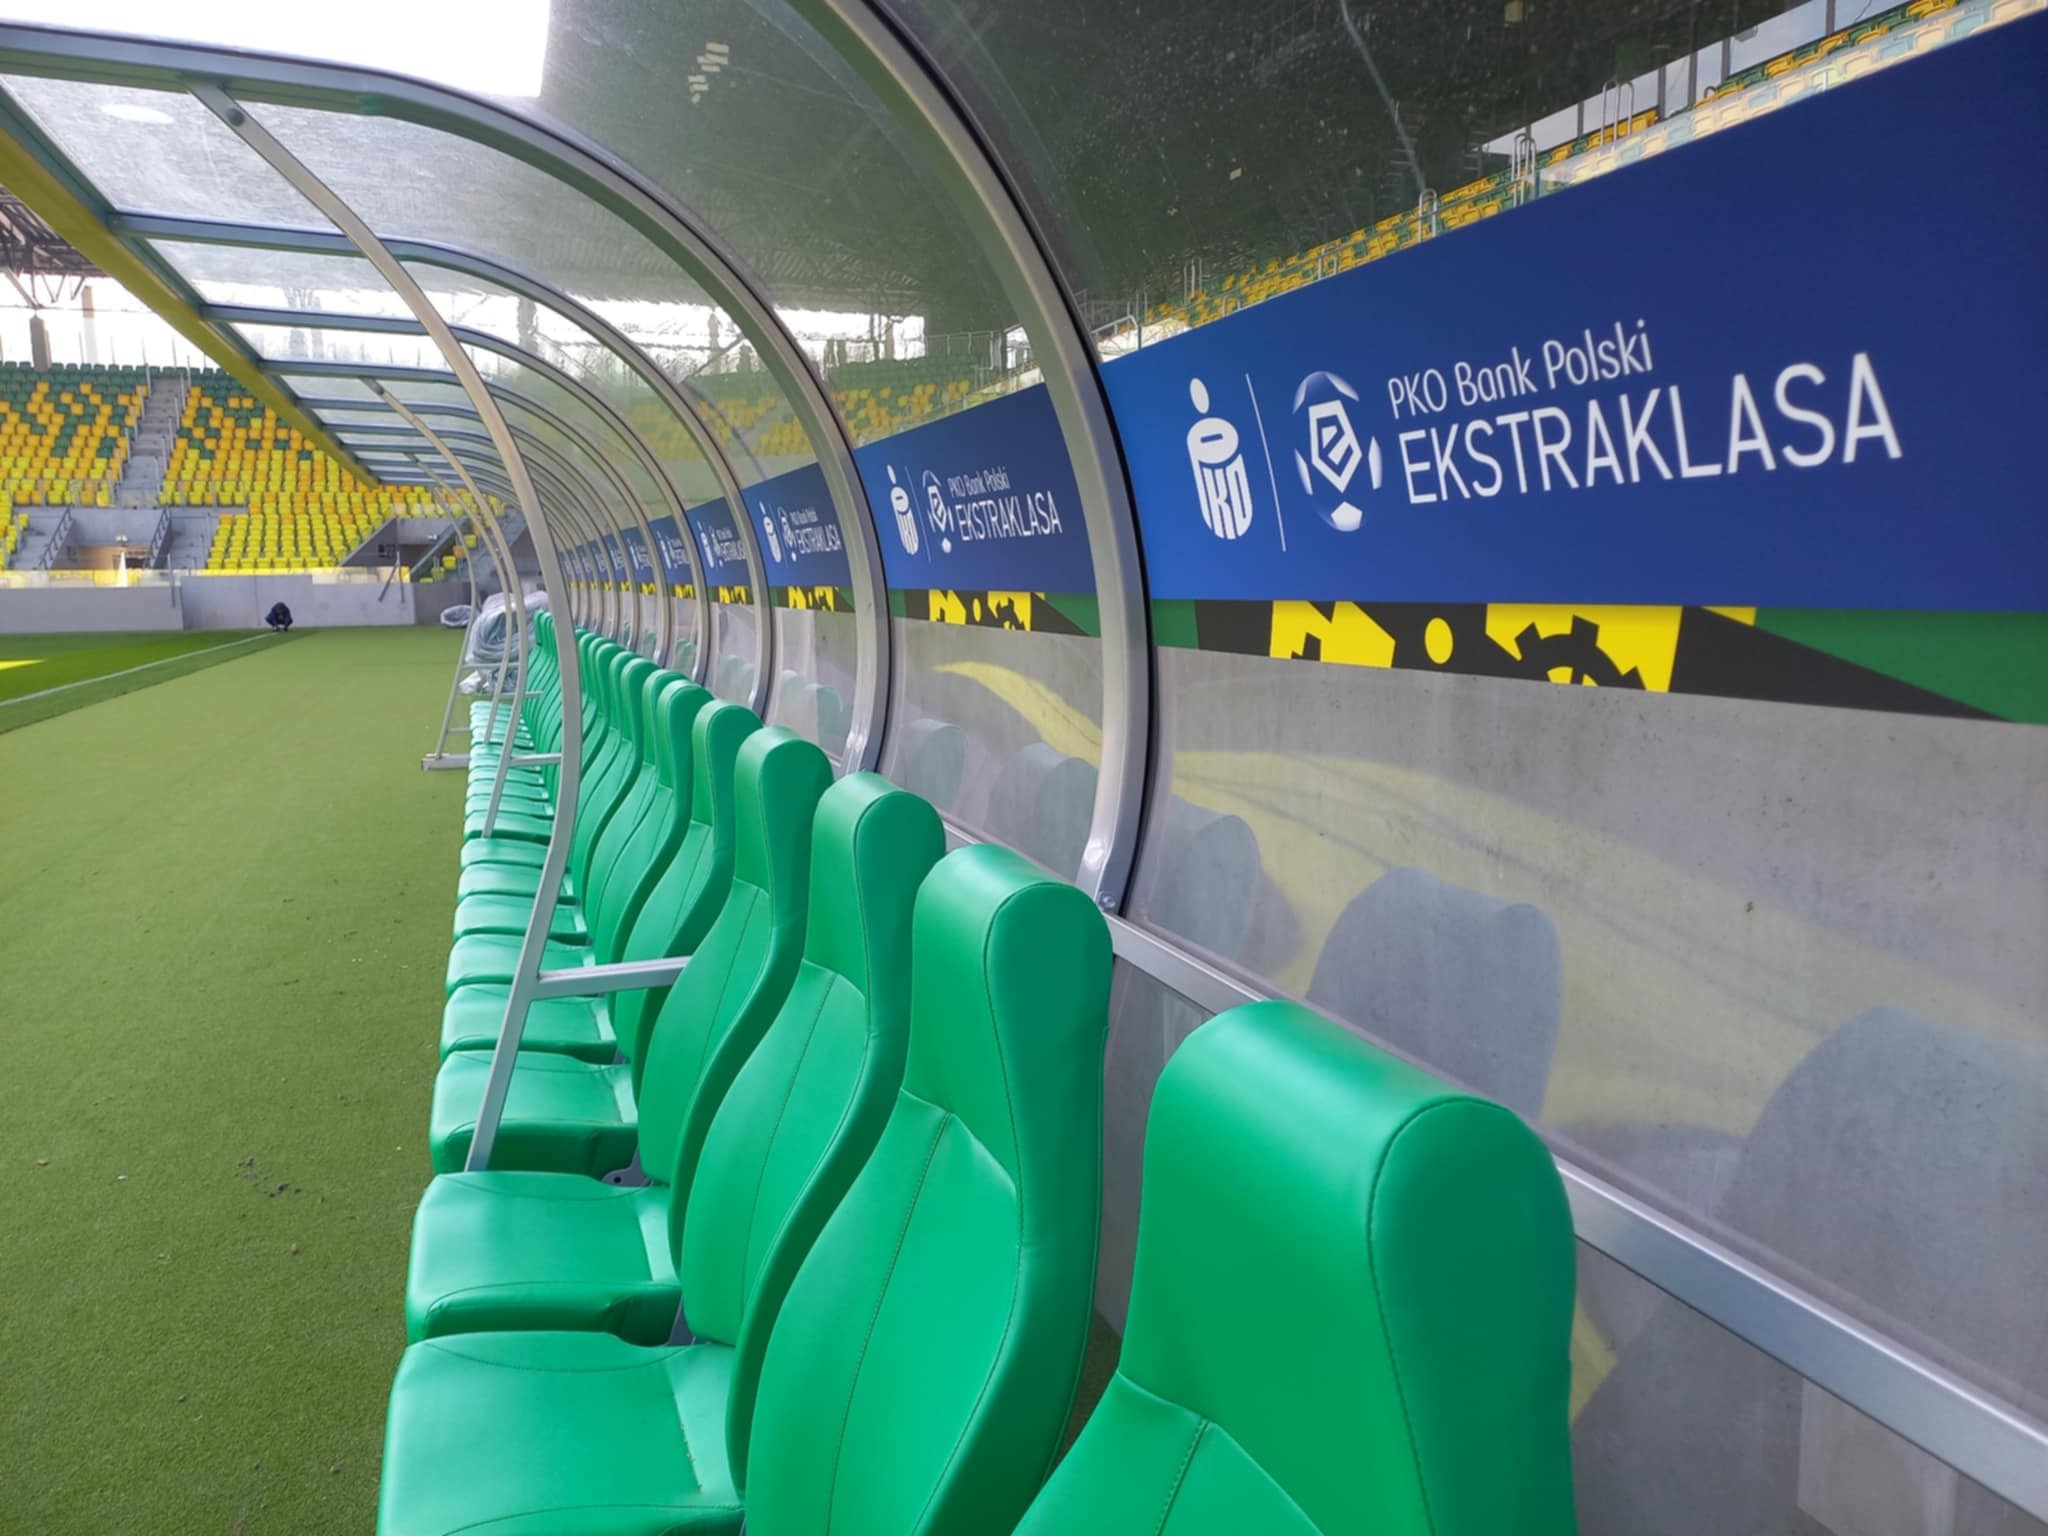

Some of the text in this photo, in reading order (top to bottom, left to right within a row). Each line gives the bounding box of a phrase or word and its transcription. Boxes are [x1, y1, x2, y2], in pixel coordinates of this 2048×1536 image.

[1388, 318, 1653, 420] PKO Bank Polski
[1398, 352, 1903, 504] EKSTRAKLASA
[955, 490, 1063, 541] EKSTRAKLASA
